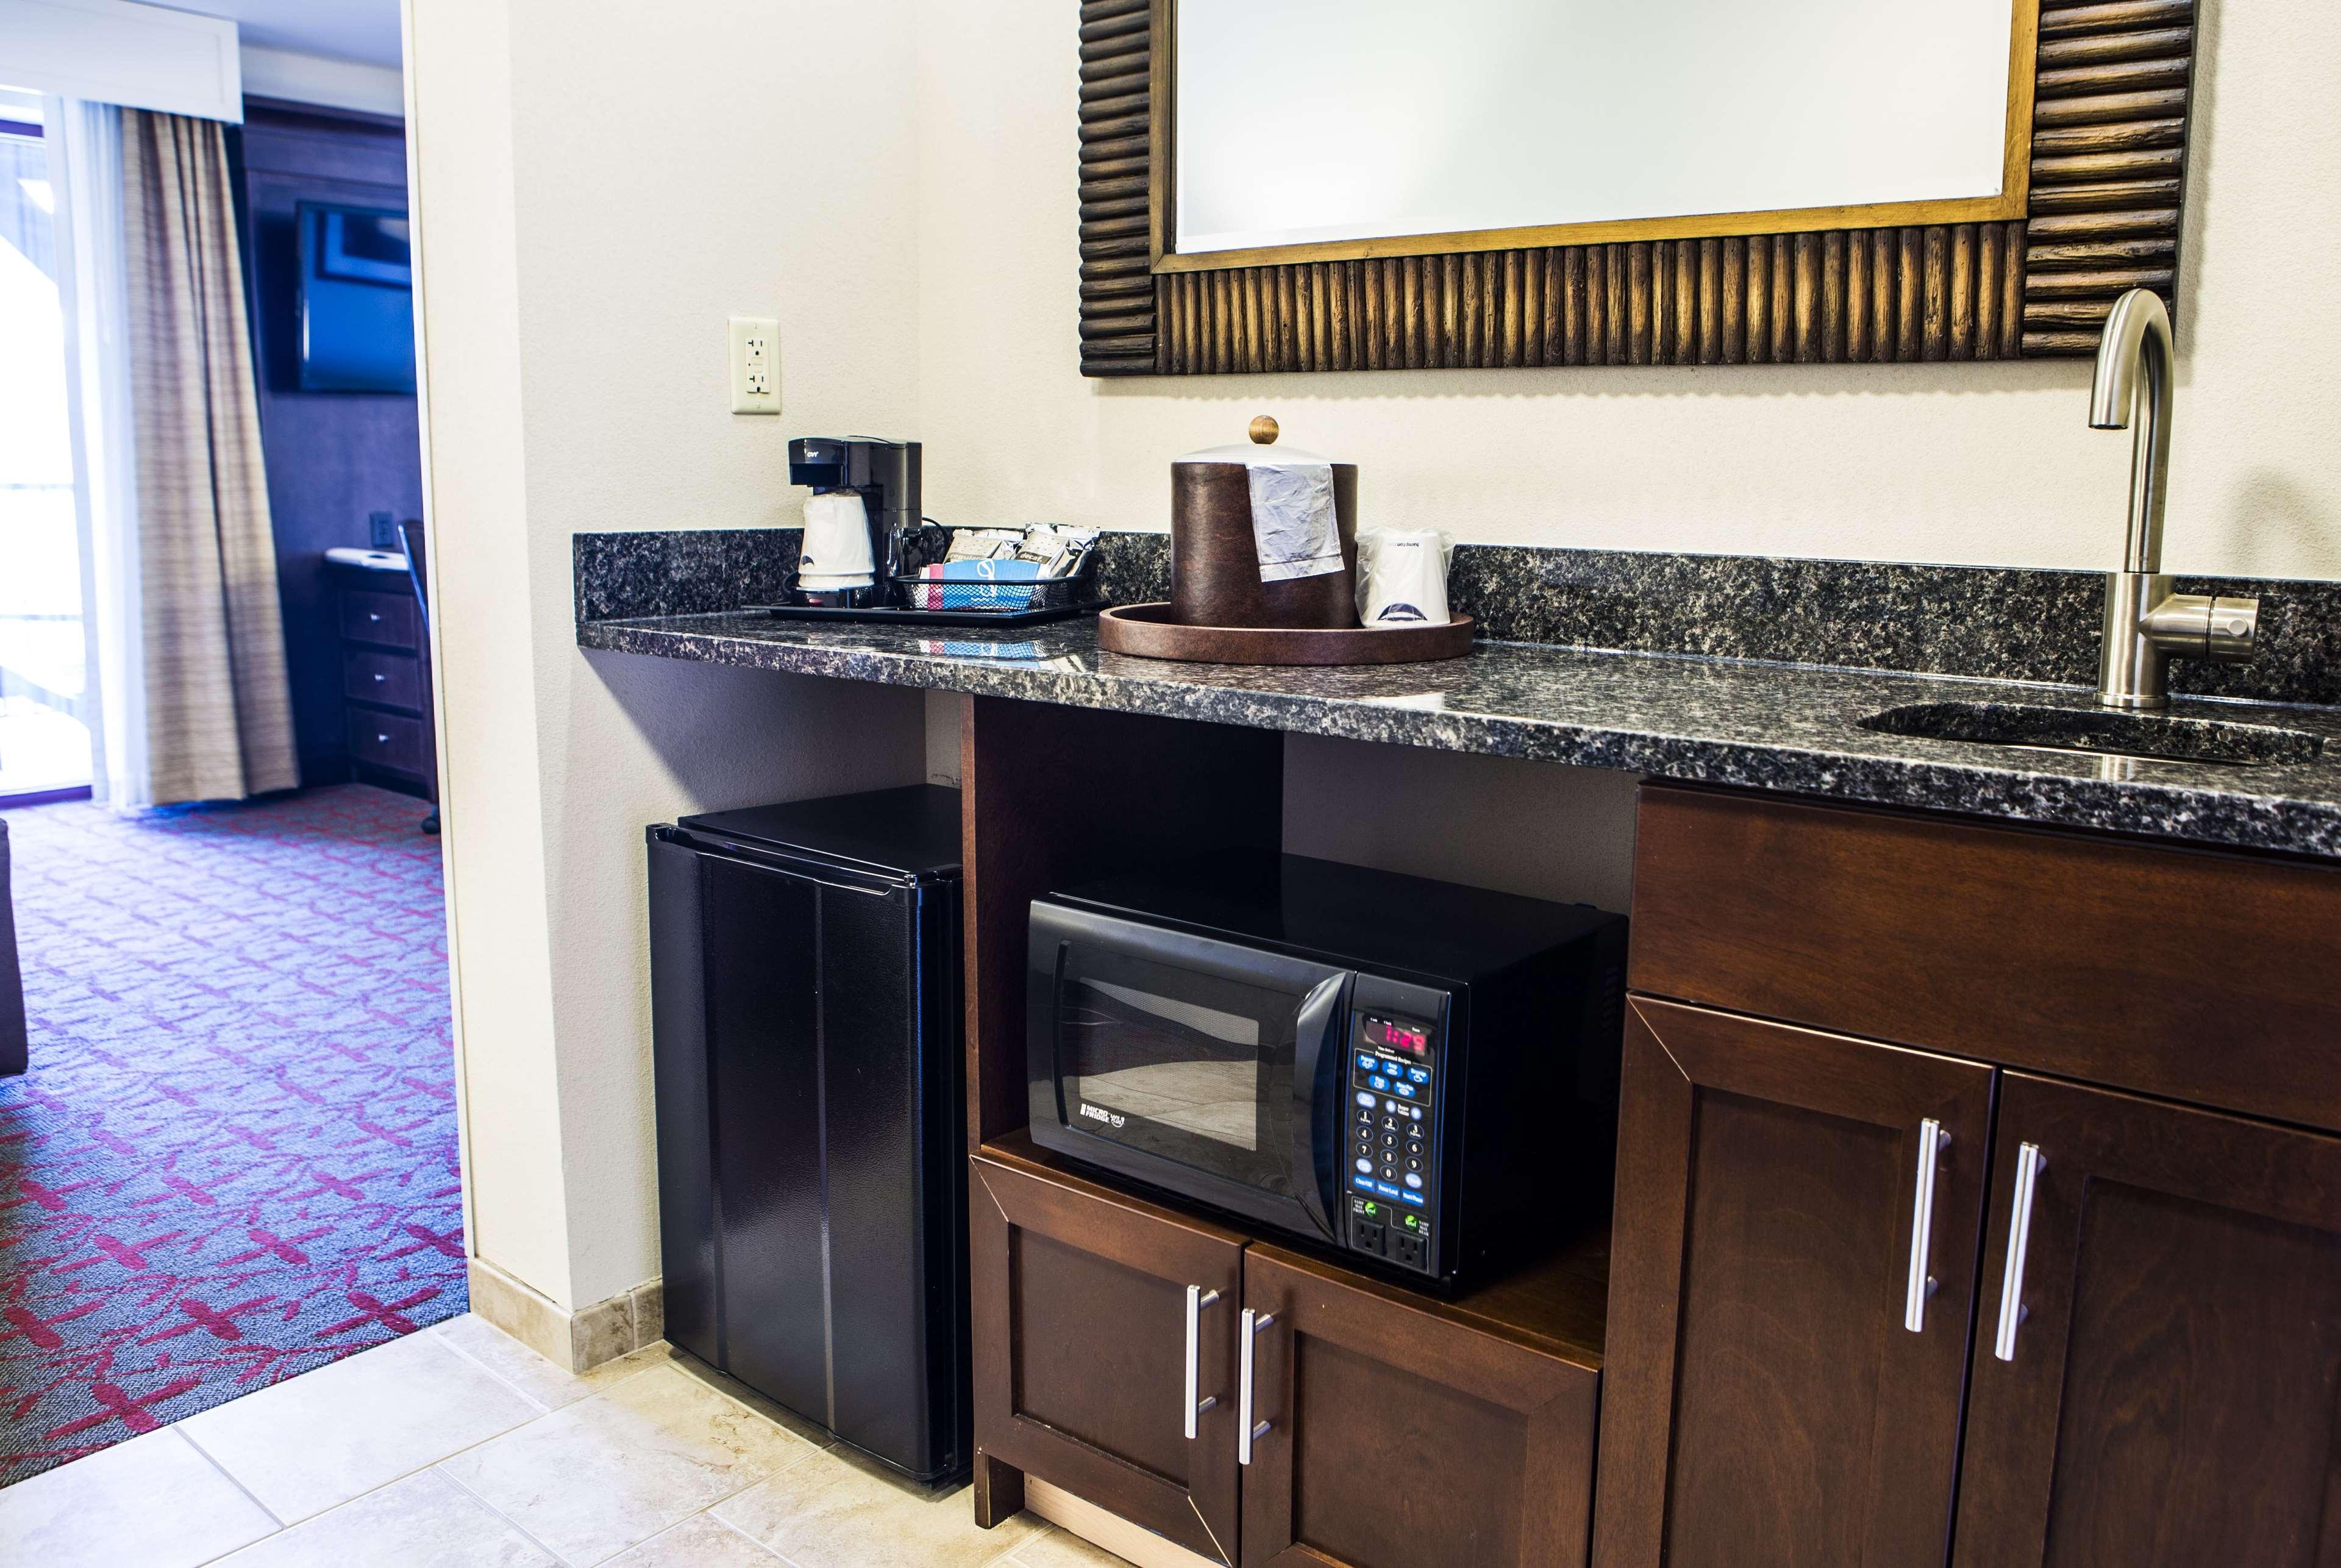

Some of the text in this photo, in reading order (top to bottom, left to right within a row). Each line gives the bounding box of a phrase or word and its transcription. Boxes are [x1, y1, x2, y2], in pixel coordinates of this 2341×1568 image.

[1020, 552, 1042, 562] decaf.
[1398, 1057, 1412, 1065] Recipes
[1086, 1105, 1108, 1117] MICRO
[1085, 1111, 1110, 1123] FRIDGE
[1363, 1111, 1367, 1120] 1
[1388, 1118, 1392, 1127] 2
[1413, 1125, 1418, 1133] 3
[1362, 1130, 1367, 1138] 4
[1387, 1136, 1392, 1145] 5
[1412, 1144, 1417, 1152] 6
[1387, 1153, 1392, 1161] 8
[1386, 1169, 1391, 1177] 0
